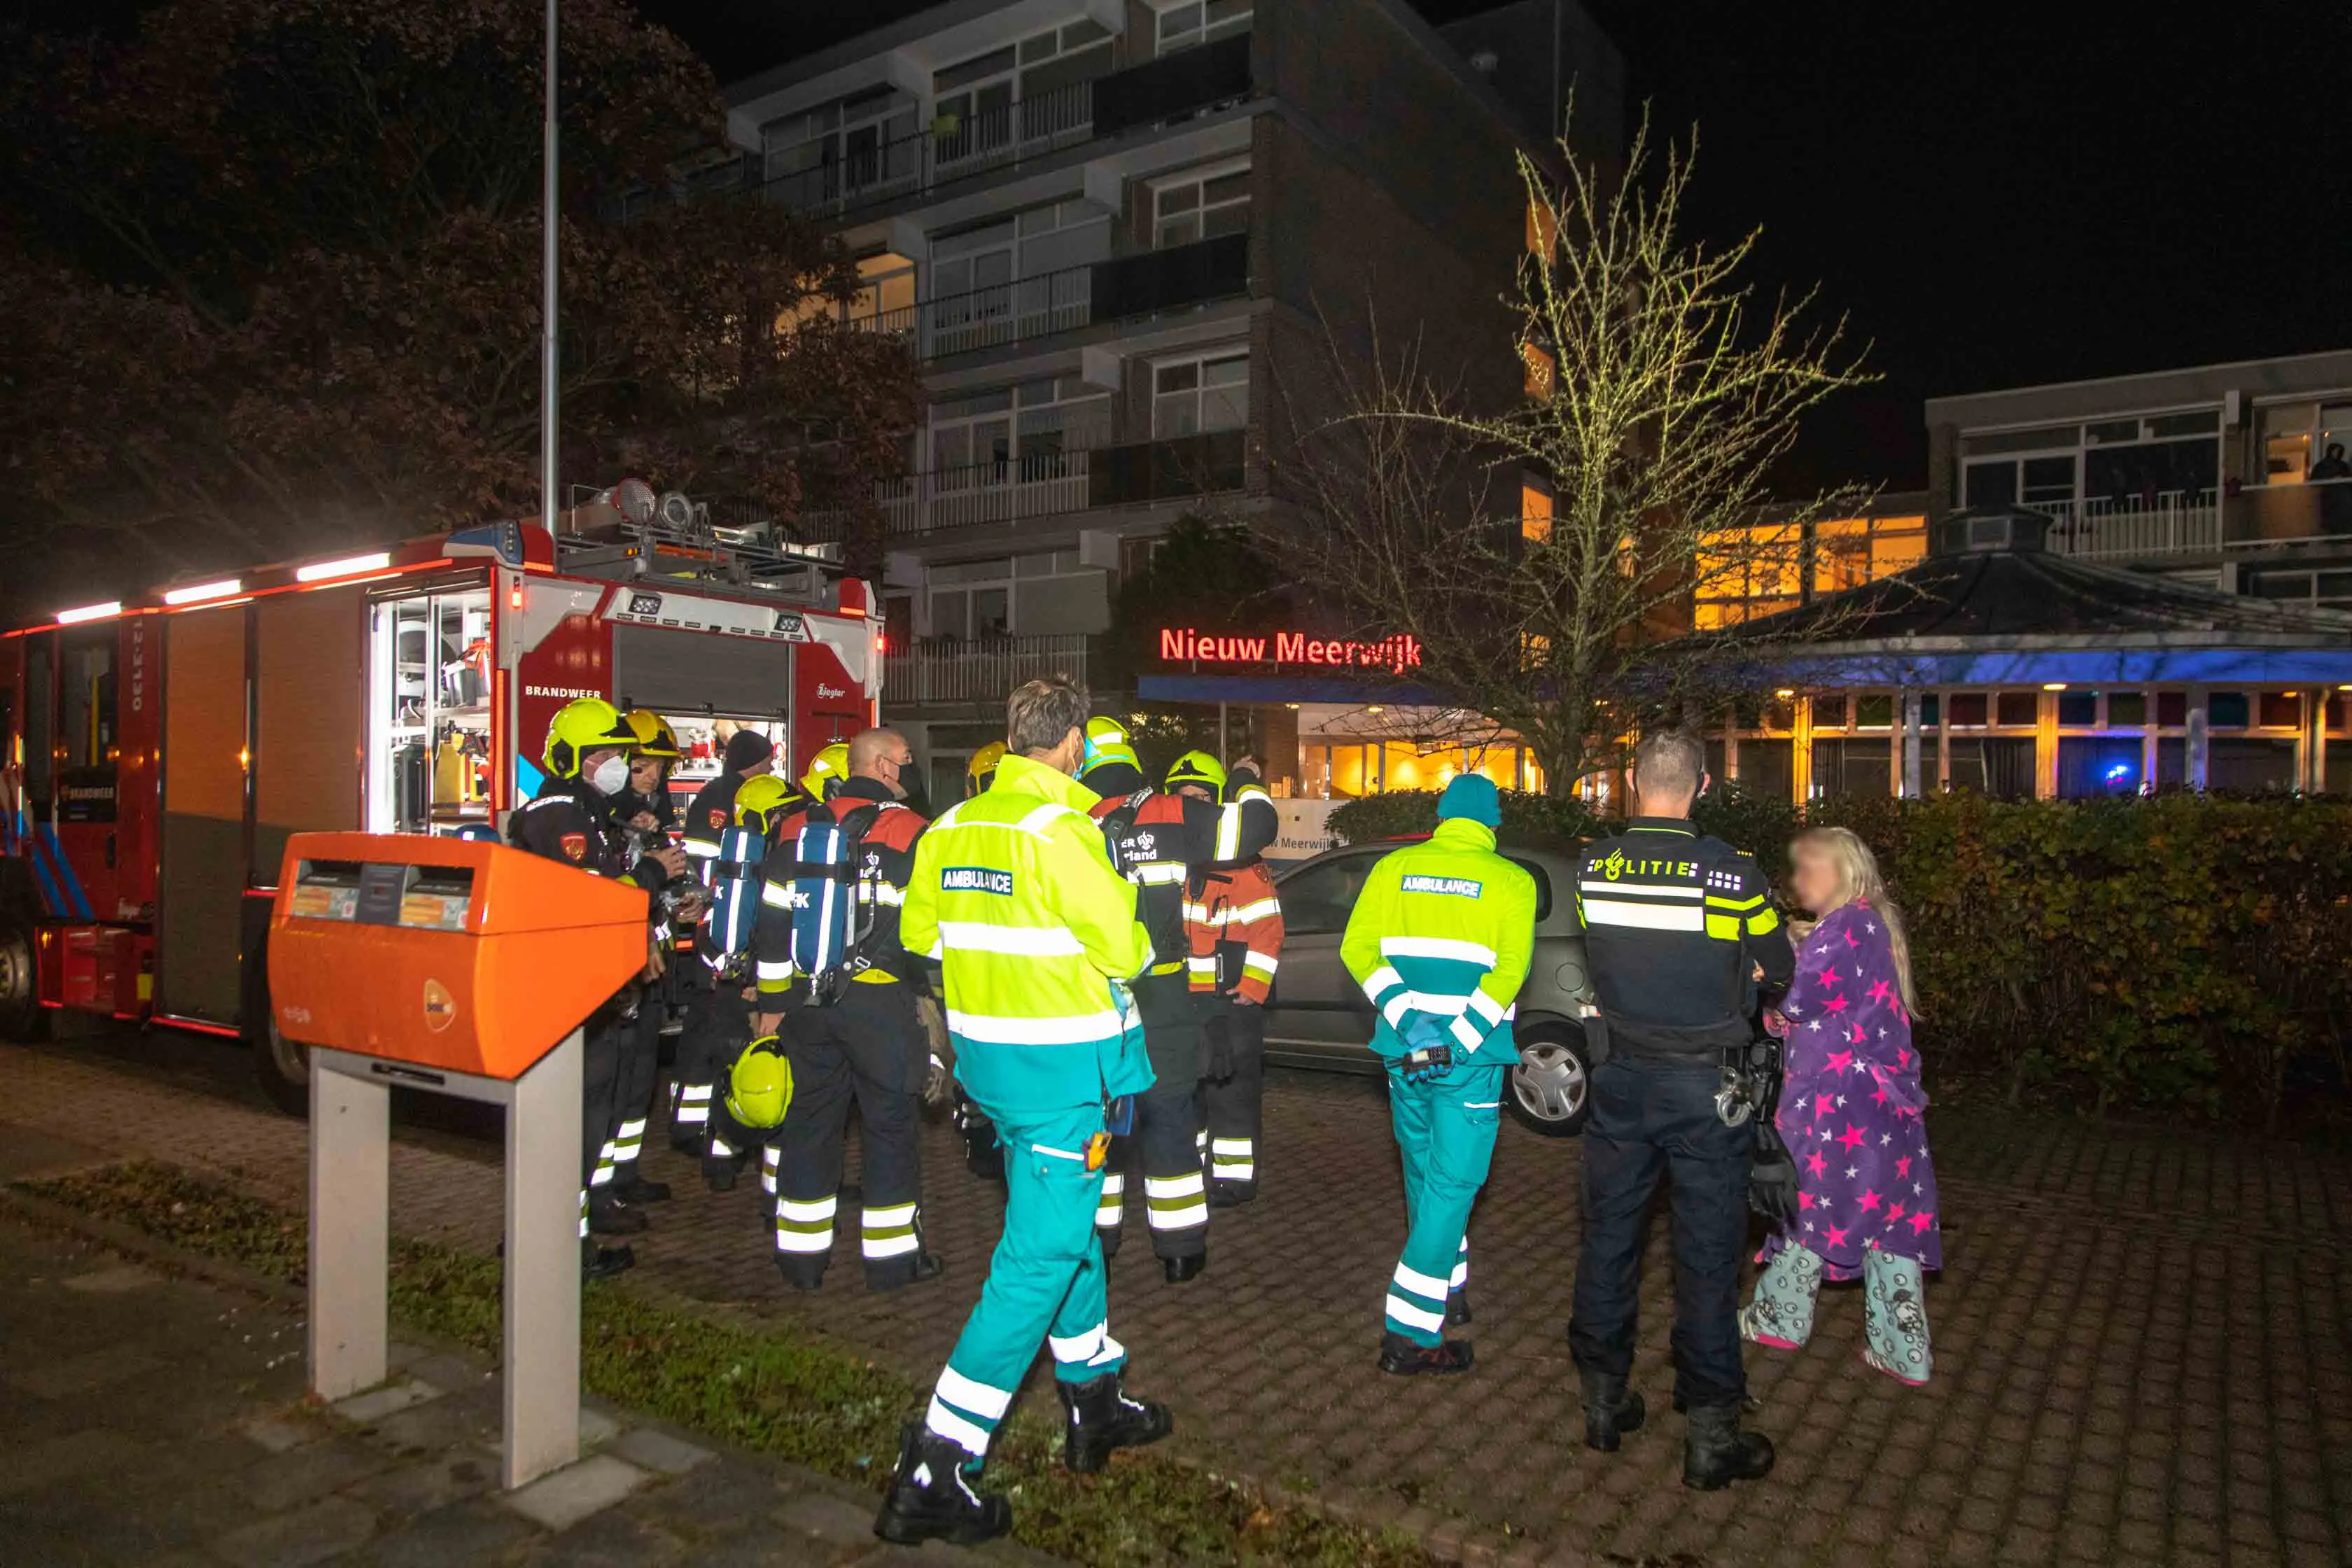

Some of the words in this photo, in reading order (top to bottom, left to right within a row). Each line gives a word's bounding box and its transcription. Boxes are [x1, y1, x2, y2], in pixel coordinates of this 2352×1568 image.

[1161, 629, 1266, 662] Nieuw
[1276, 631, 1422, 674] Meerwijk
[526, 685, 601, 699] BRANDWEER
[943, 870, 1011, 892] AMBULANCE
[1594, 859, 1689, 881] POLITIE
[1402, 877, 1480, 897] AMBULANCE
